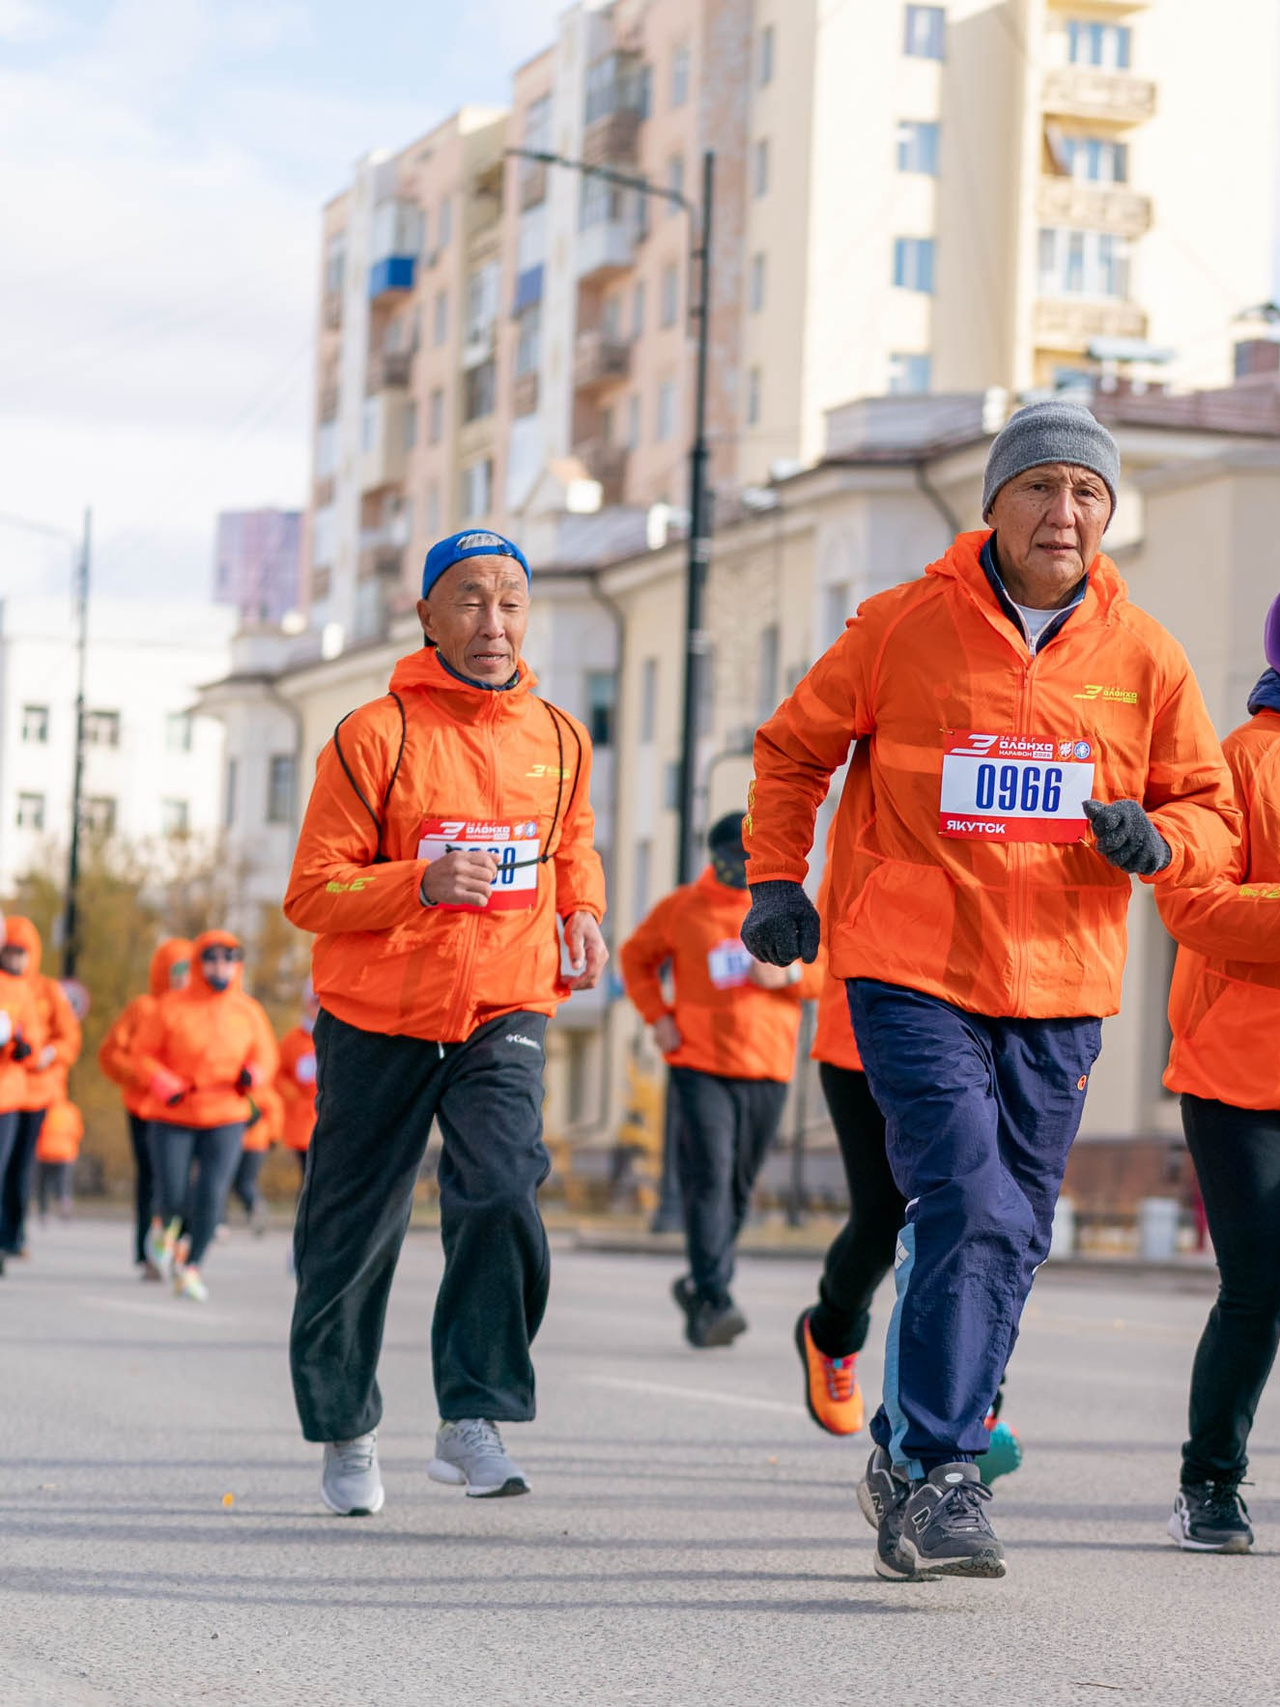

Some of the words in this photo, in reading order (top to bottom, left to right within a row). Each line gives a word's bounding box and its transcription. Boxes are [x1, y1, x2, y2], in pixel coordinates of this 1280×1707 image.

[999, 741, 1054, 751] ОЛОНХО
[976, 764, 1063, 812] 0966
[946, 820, 1006, 834] ЯКУТСК
